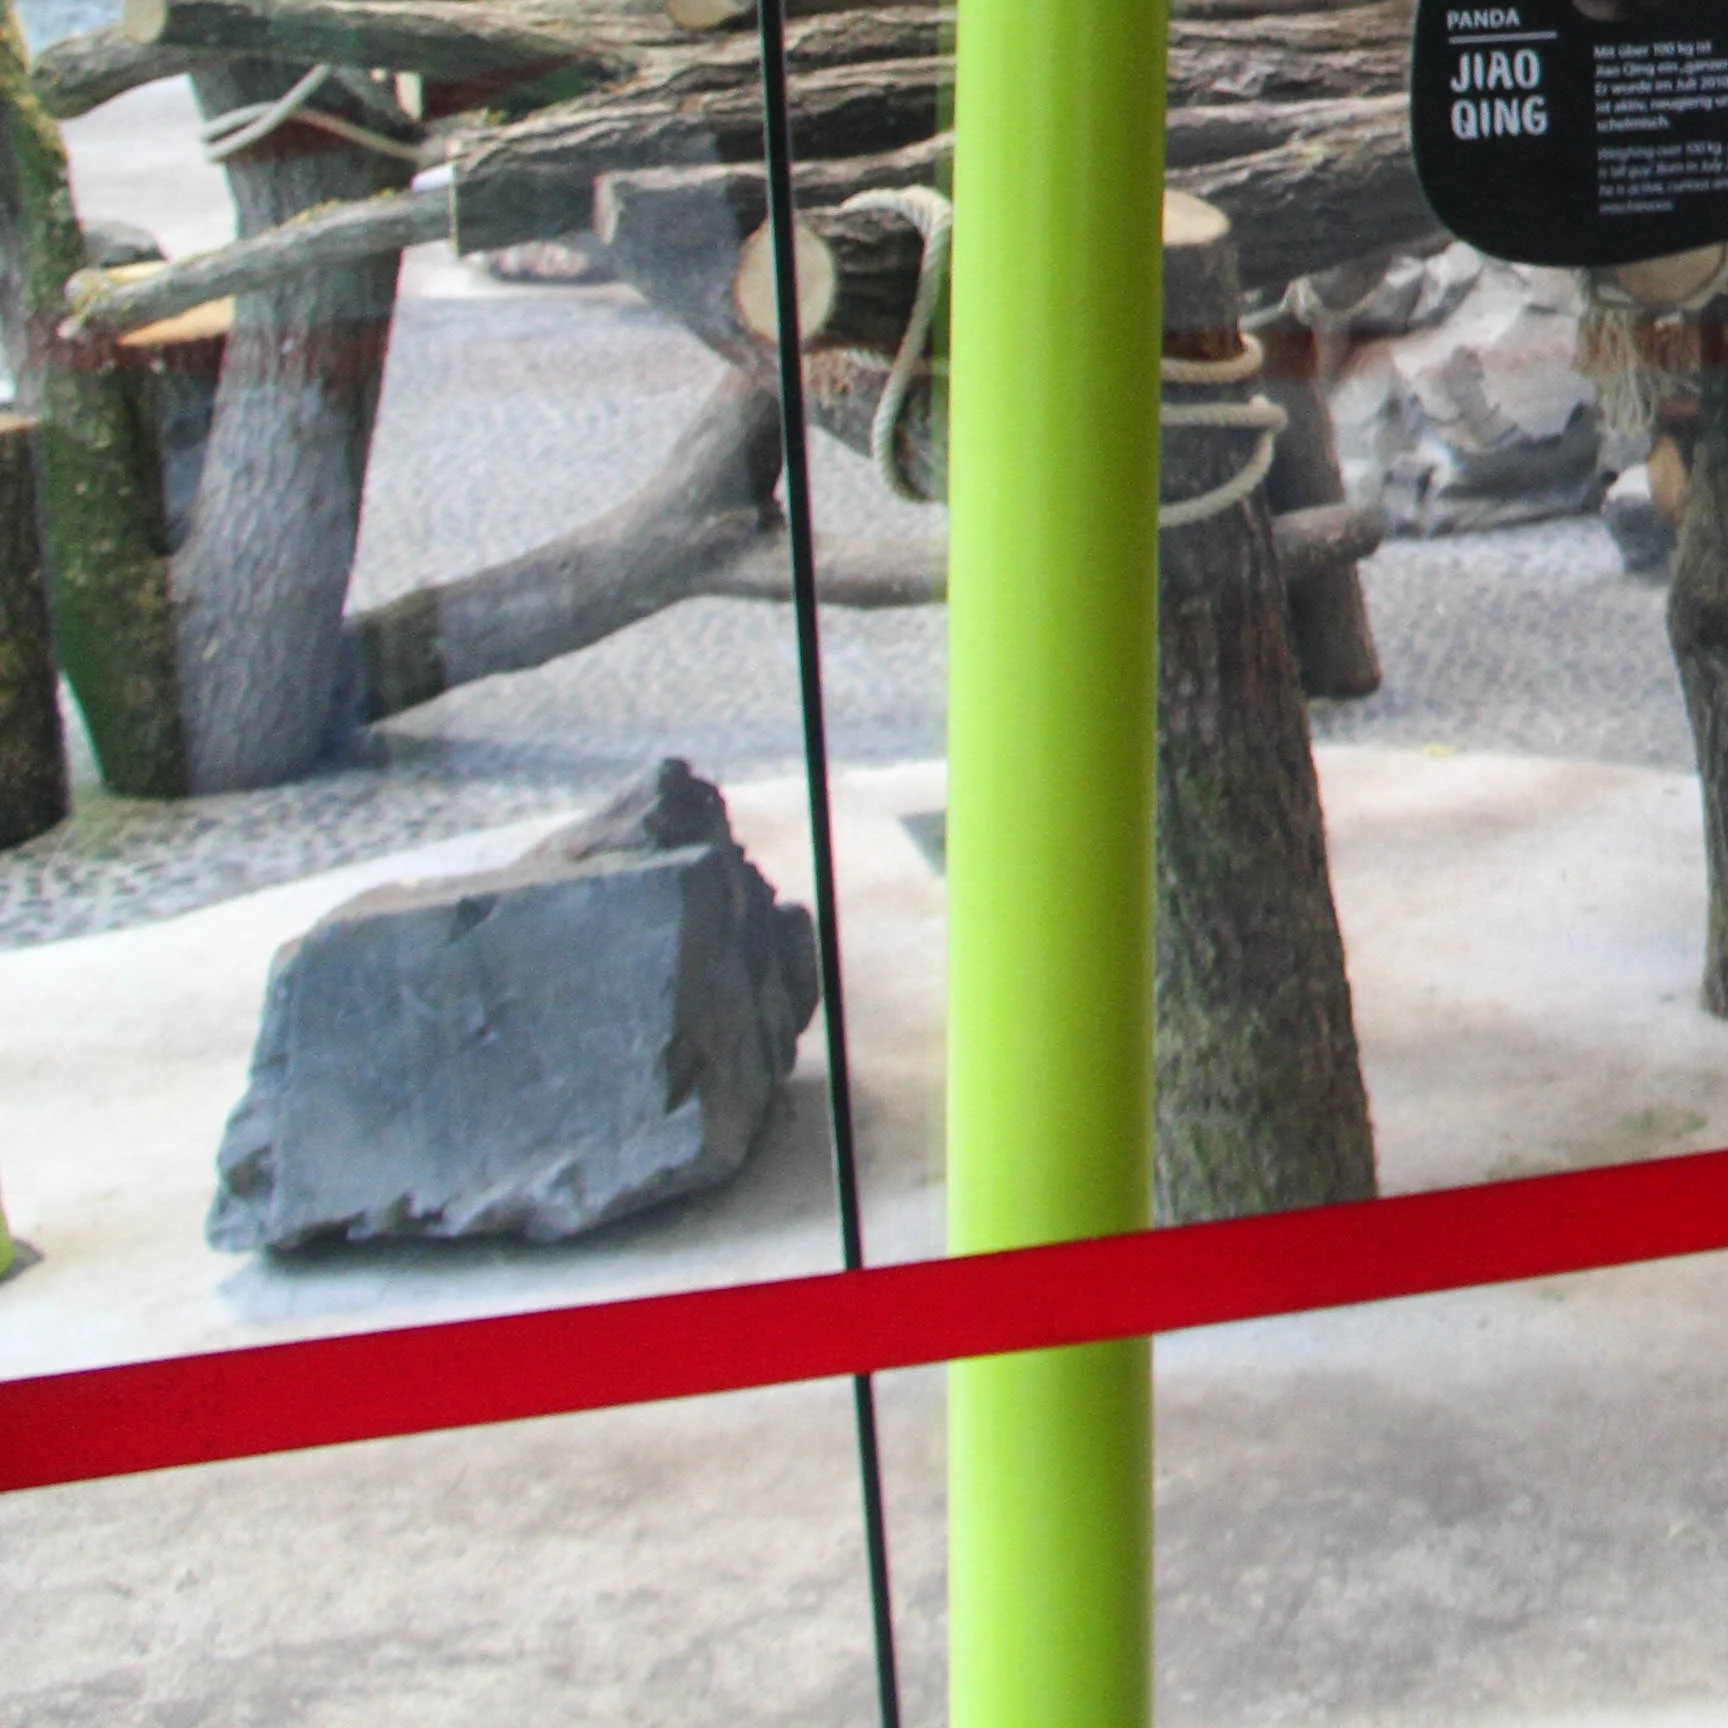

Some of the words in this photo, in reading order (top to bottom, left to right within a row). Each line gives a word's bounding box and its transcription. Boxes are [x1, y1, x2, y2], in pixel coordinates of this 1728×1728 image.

[1446, 7, 1520, 31] PANDA
[1449, 48, 1541, 93] JIAO
[1450, 95, 1549, 140] QING
